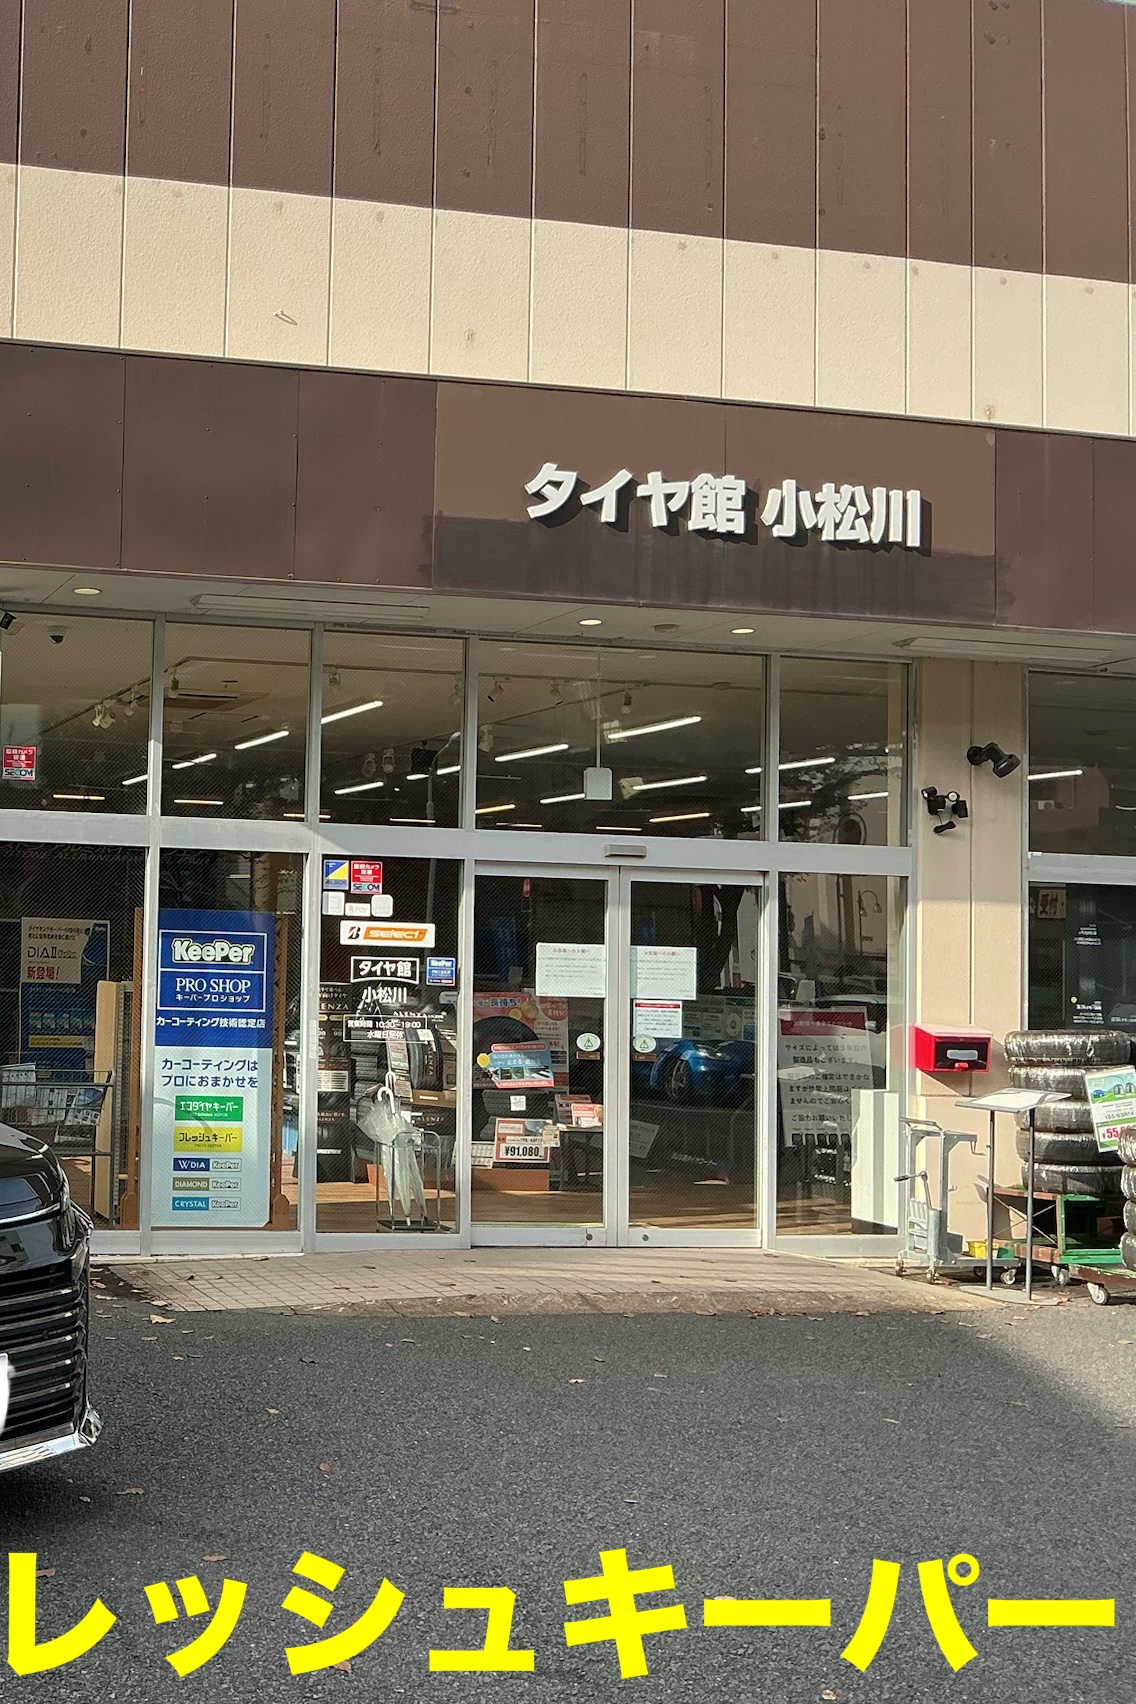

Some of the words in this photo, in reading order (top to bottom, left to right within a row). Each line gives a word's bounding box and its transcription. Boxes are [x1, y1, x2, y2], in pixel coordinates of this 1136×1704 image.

[523, 462, 746, 534] タイヤ館
[760, 478, 921, 548] 小松川
[352, 883, 380, 891] SECOM
[368, 929, 421, 940] select
[171, 938, 256, 965] KeePer
[358, 961, 412, 977] タイヤ館
[175, 978, 207, 993] PRO
[209, 979, 252, 994] SHOP
[361, 986, 408, 1003] 小松川
[156, 1016, 266, 1029] カーコーティング技術認定店
[161, 1058, 259, 1072] カーコーティングは
[161, 1075, 259, 1089] プロにおまかせを
[178, 1132, 238, 1143] フレッシュキーパー
[211, 1161, 240, 1170] KeePer
[174, 1180, 208, 1189] DIAMOND
[211, 1180, 240, 1189] KeePer
[174, 1199, 207, 1208] CRYSTAL
[211, 1199, 239, 1208] KeePer
